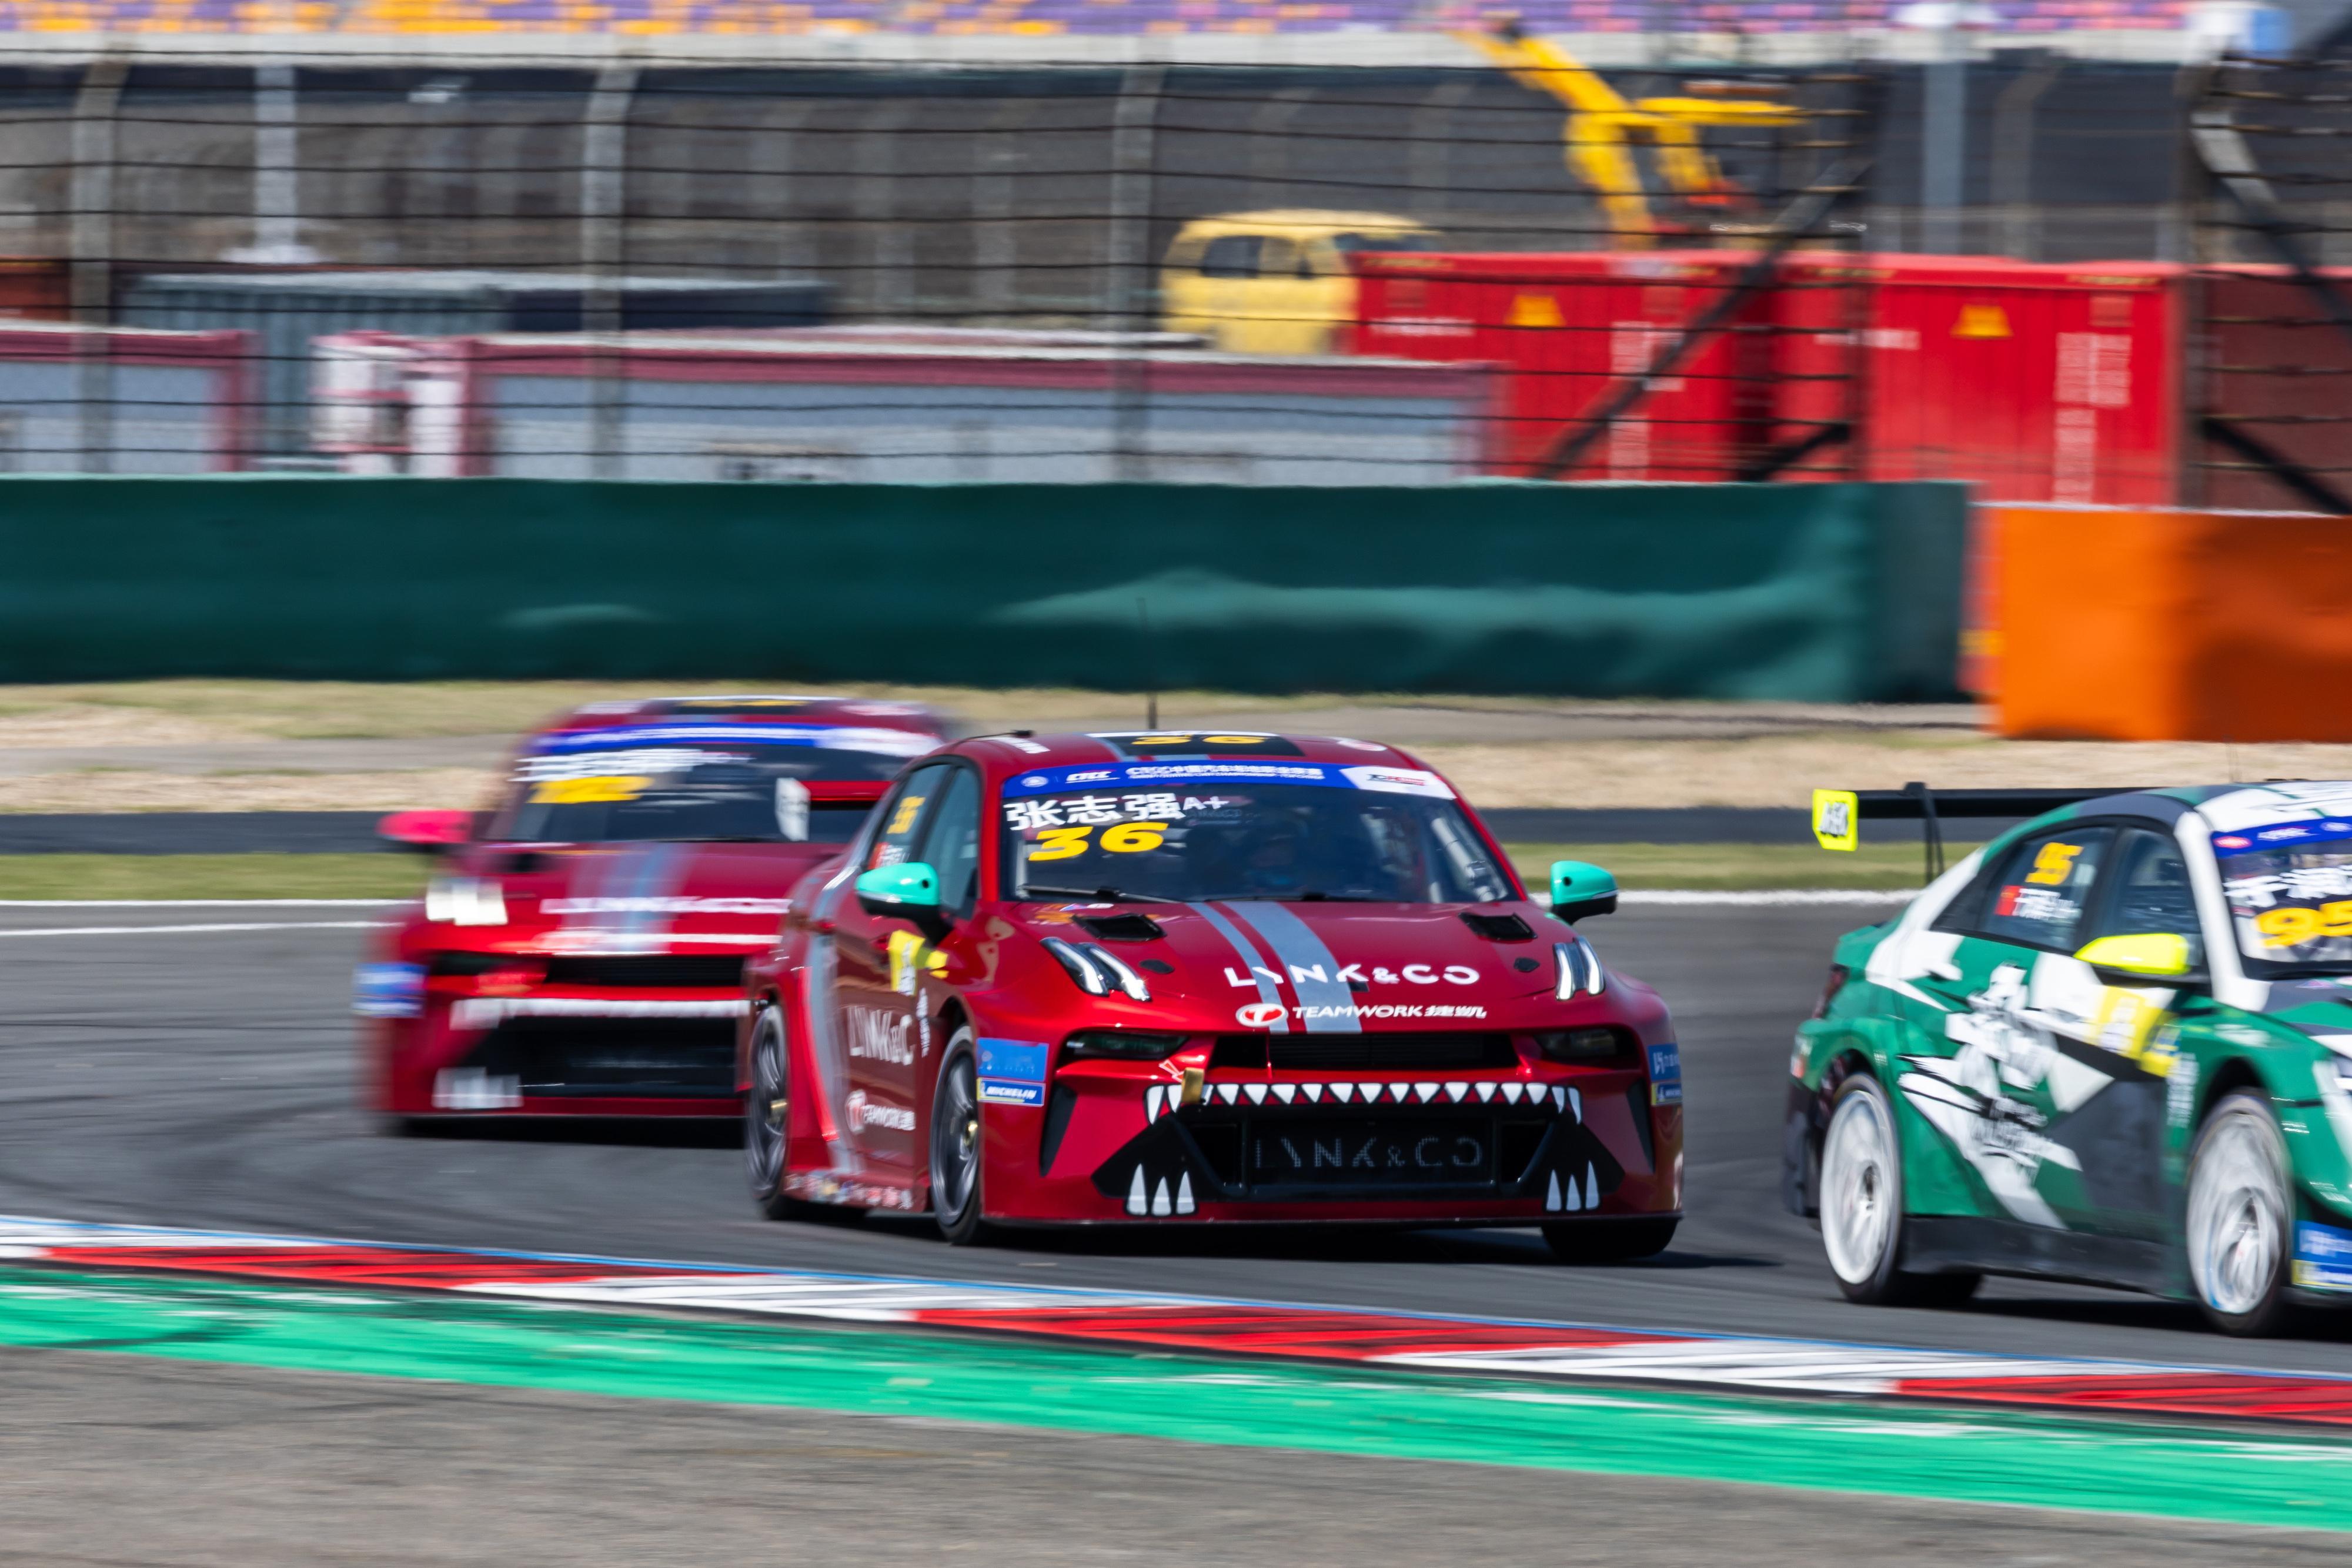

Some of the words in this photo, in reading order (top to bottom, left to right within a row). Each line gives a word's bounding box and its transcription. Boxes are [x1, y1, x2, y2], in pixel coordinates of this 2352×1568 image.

[1003, 793, 1186, 831] 张志强
[1028, 822, 1170, 861] 36
[1224, 964, 1481, 987] LYNK&CO
[1292, 1005, 1423, 1018] TEAMWORK
[1253, 1136, 1482, 1168] LYNK&CO
